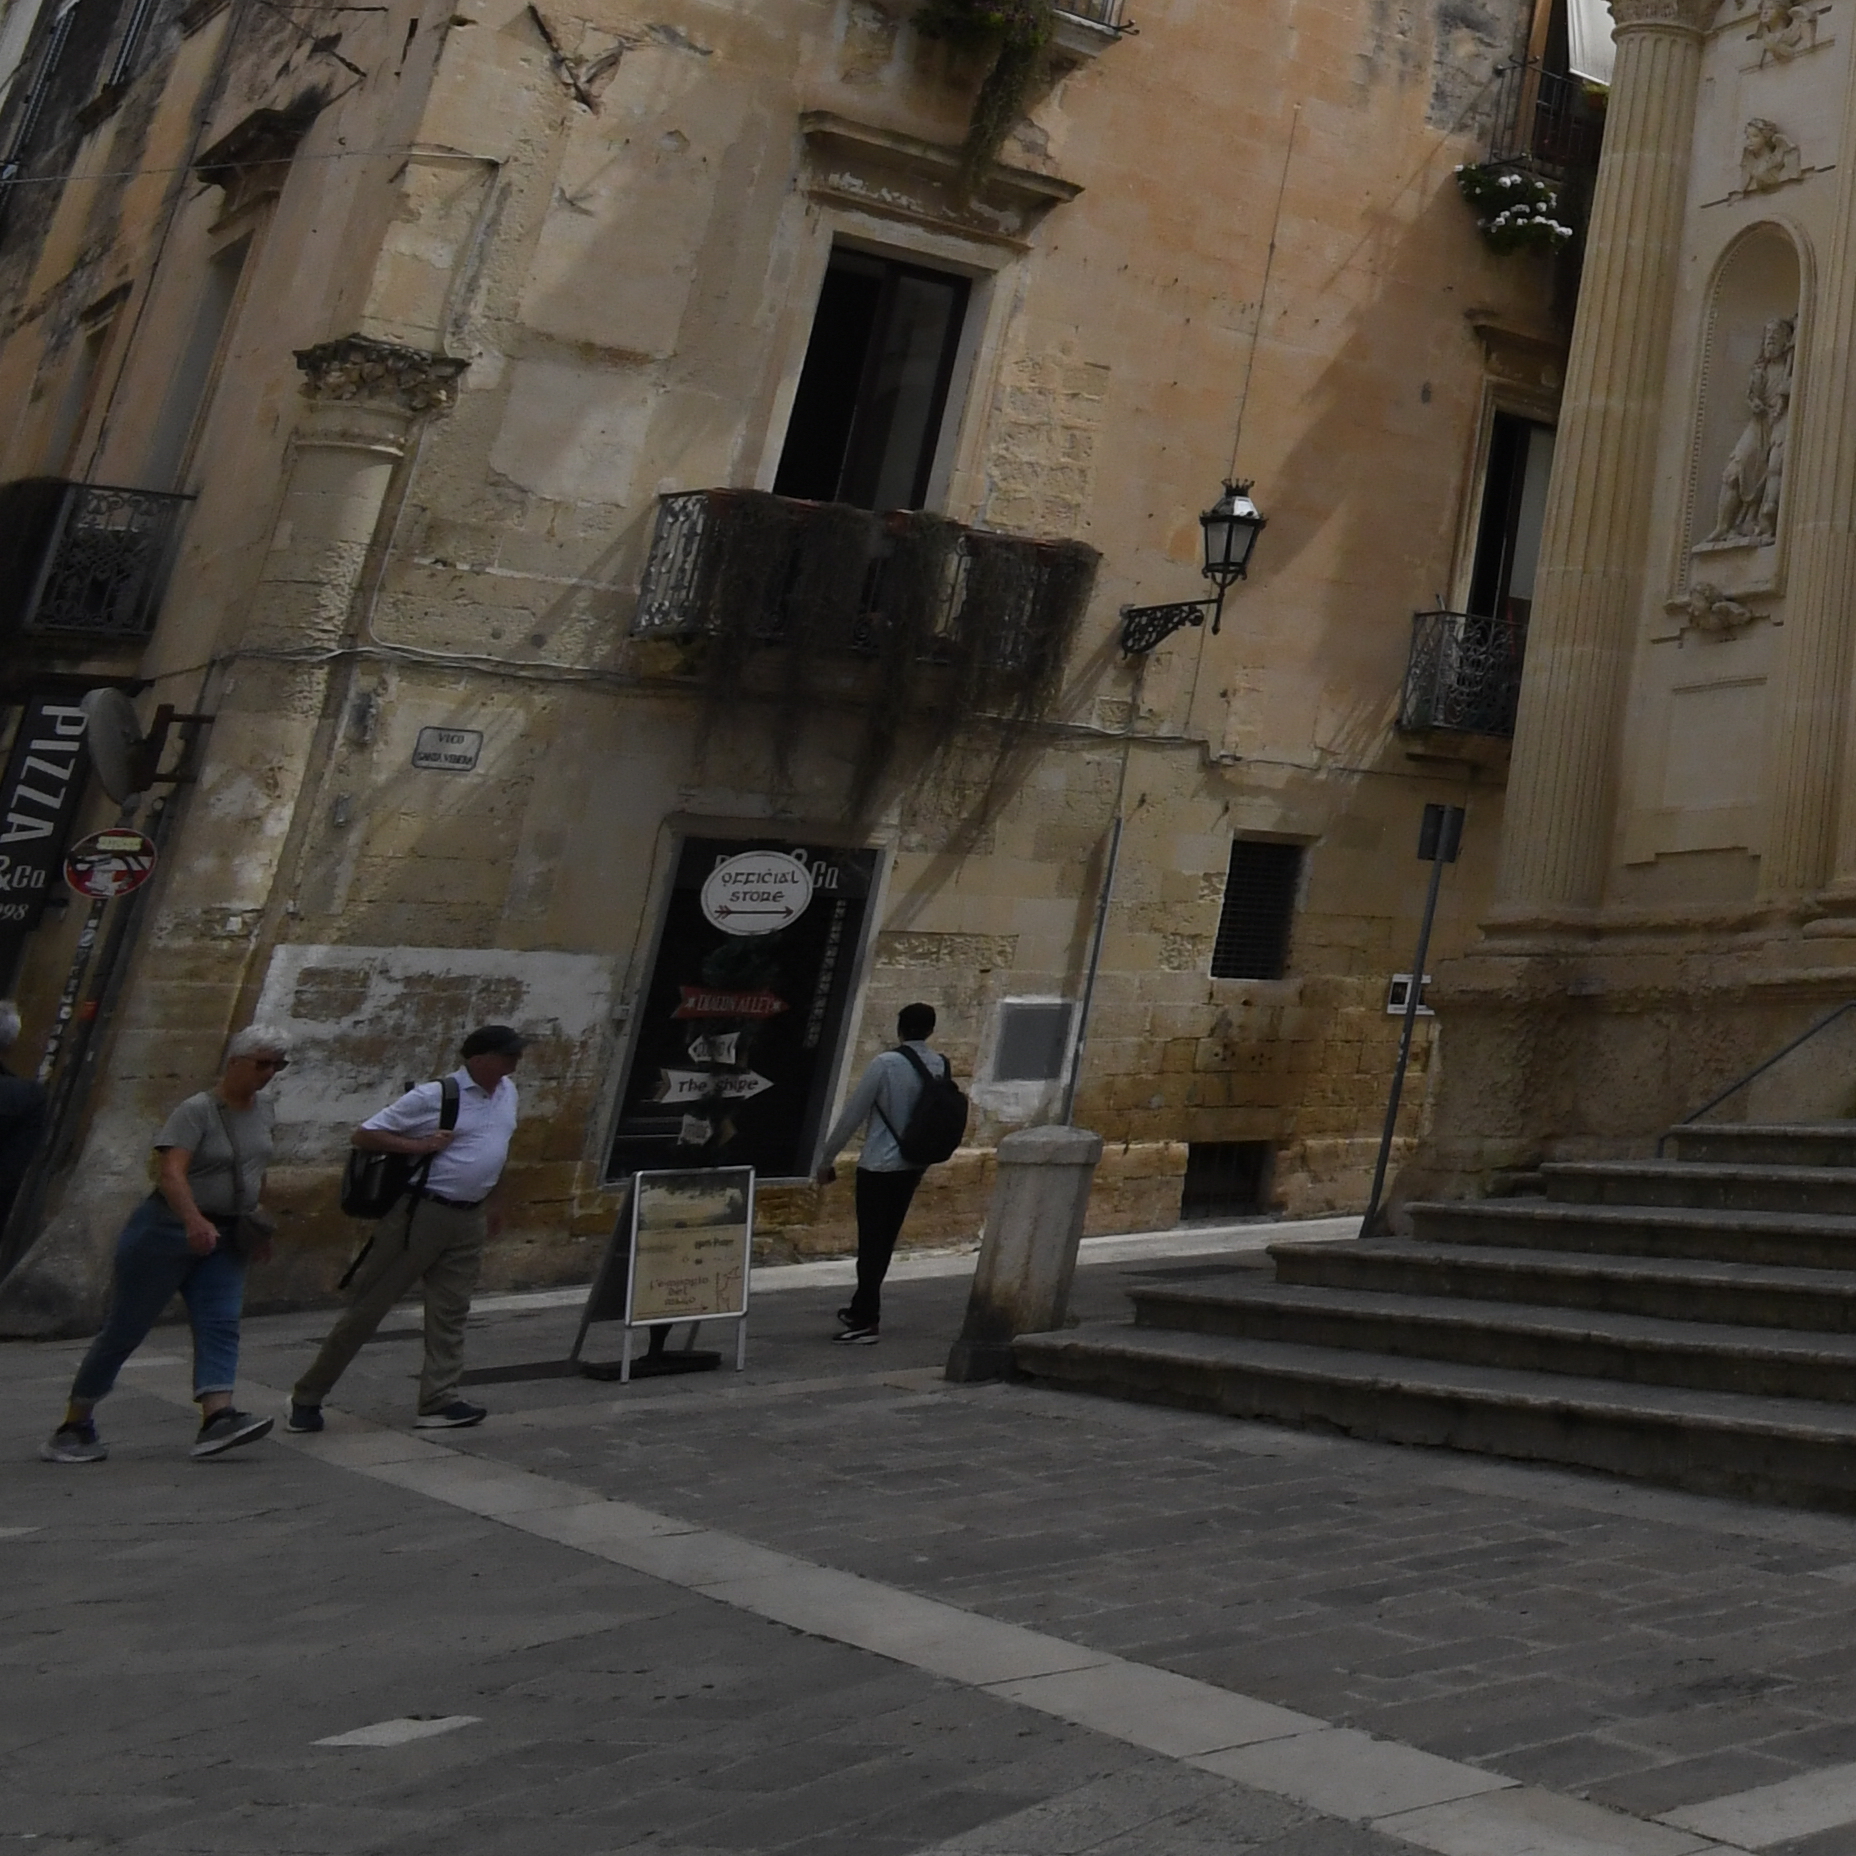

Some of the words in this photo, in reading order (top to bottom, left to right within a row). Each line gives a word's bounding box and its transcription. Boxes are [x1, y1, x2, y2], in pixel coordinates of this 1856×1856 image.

[438, 732, 465, 745] VICO
[0, 704, 89, 843] PIZZA
[721, 869, 800, 887] OFFICIAL
[729, 890, 785, 903] STORE
[0, 903, 30, 921] 98
[678, 1078, 707, 1093] The
